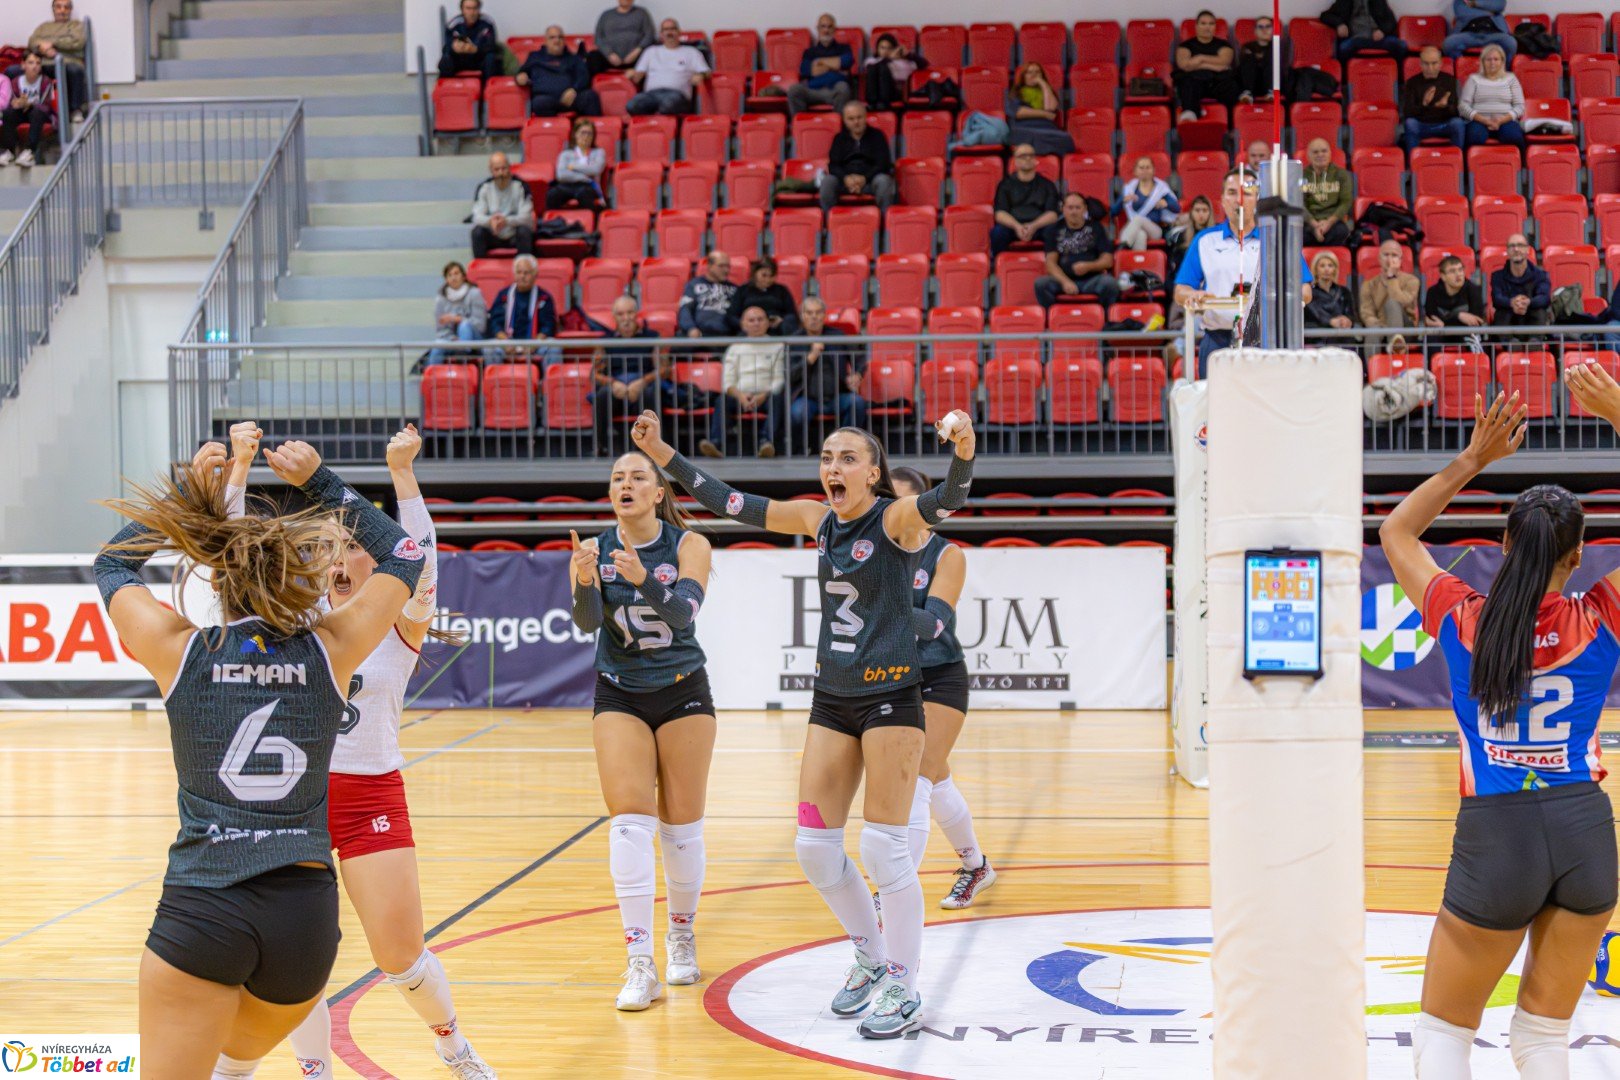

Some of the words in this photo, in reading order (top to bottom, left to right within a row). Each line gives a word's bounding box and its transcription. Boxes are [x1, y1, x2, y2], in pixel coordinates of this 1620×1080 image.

[825, 580, 865, 637] 3
[614, 605, 674, 650] 15
[212, 663, 307, 687] IGMAN
[1026, 676, 1066, 689] KFT
[218, 698, 308, 801] 6
[371, 814, 391, 833] 18
